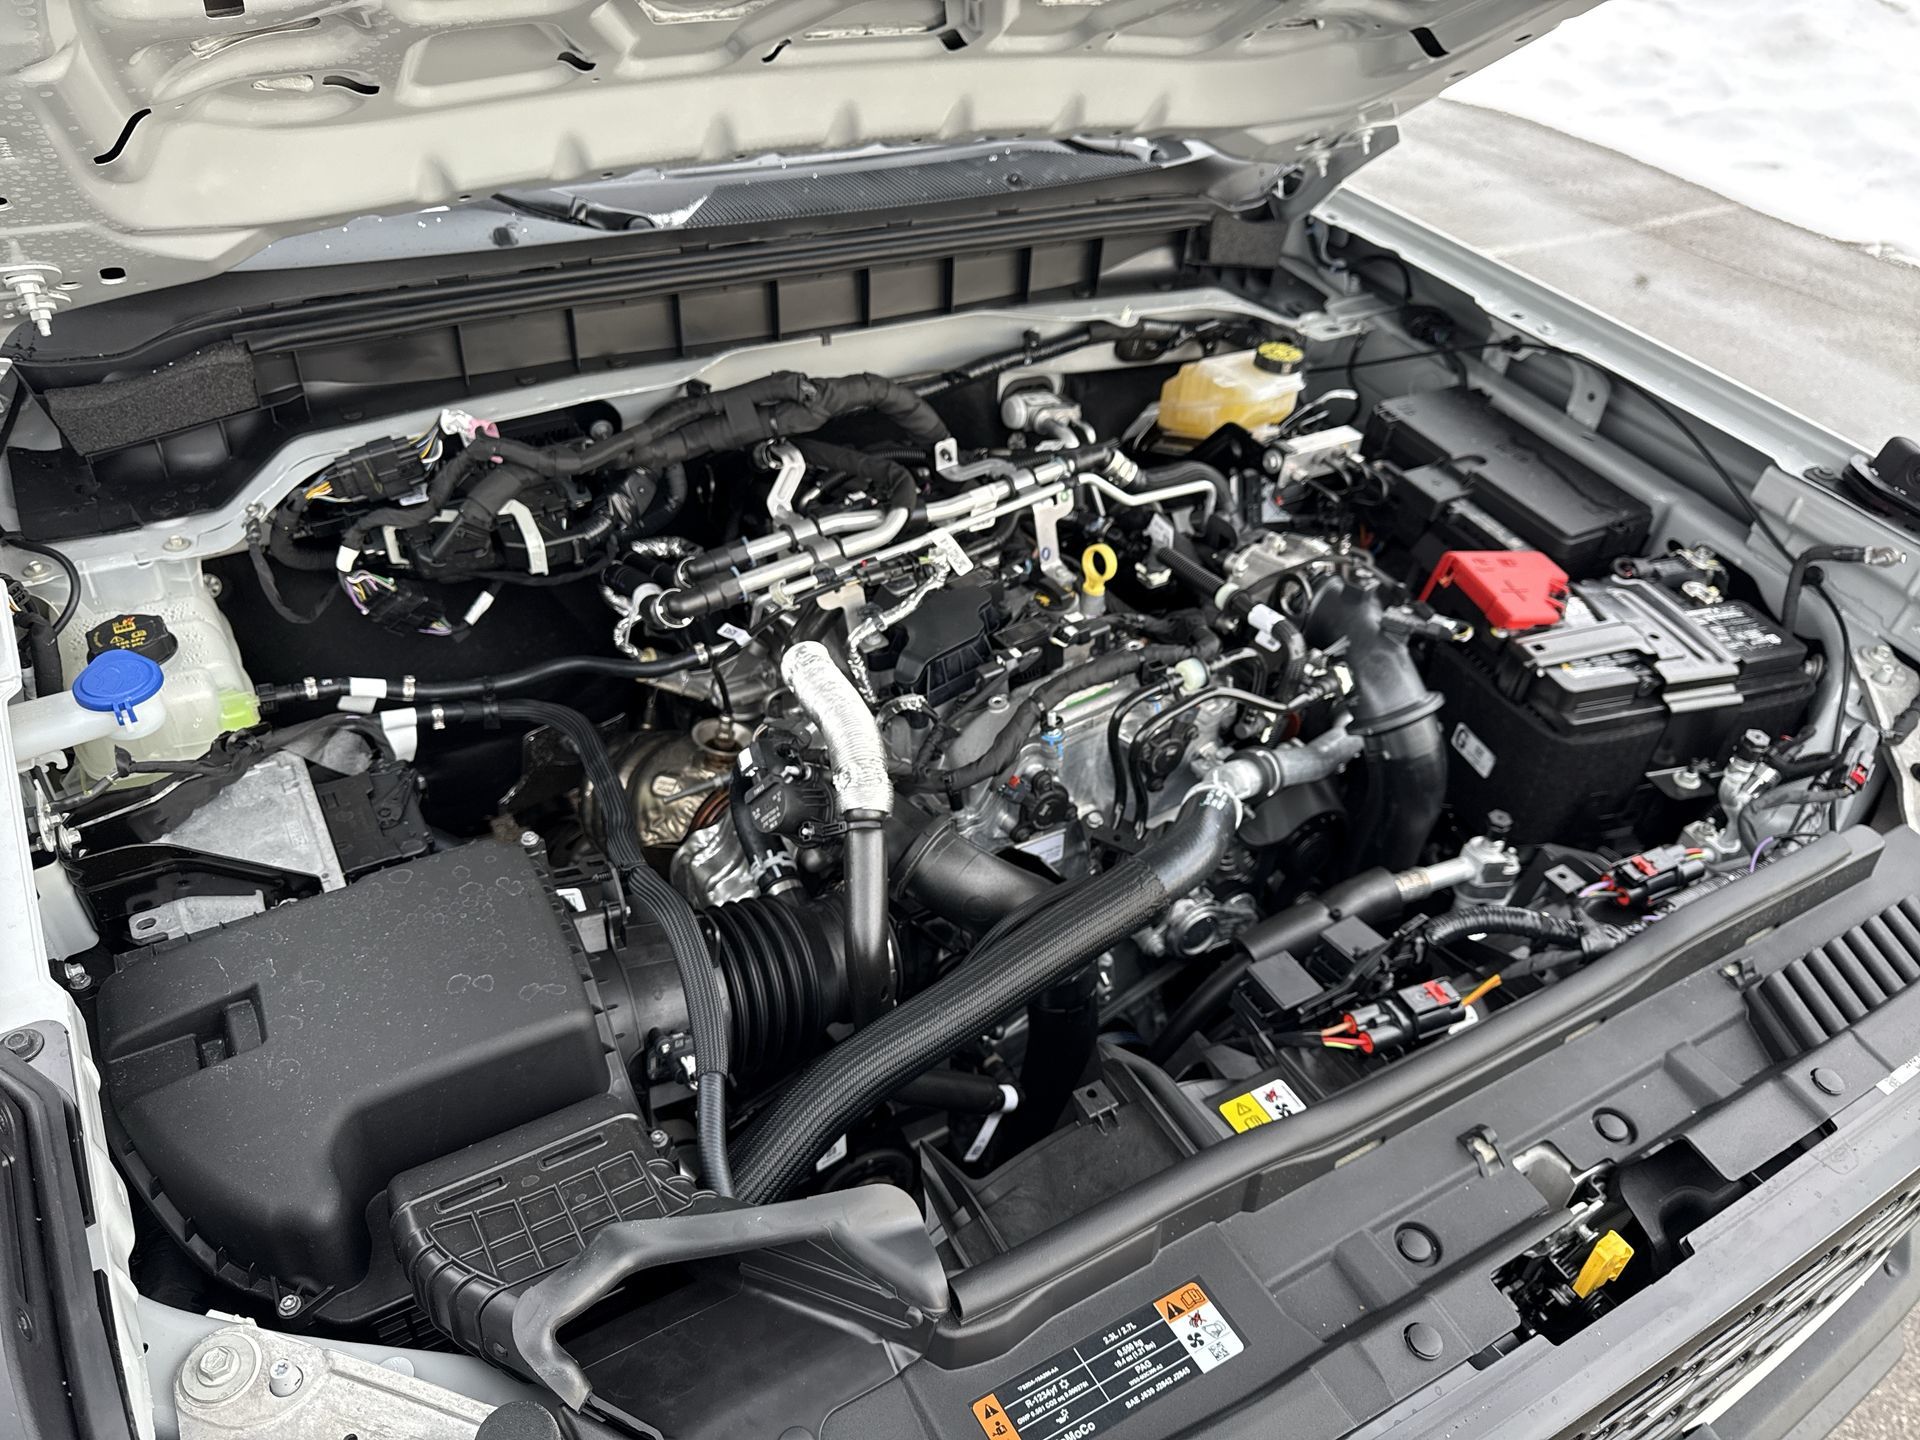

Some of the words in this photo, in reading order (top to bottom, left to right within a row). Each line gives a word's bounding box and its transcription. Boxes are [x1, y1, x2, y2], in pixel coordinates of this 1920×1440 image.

[1103, 1331, 1118, 1345] 2.3L
[1120, 1322, 1137, 1336] 2.7L
[1117, 1342, 1134, 1357] 0.550
[1132, 1339, 1144, 1351] kg
[1134, 1360, 1152, 1374] PAG
[1025, 1384, 1058, 1408] R-1234yf
[1125, 1396, 1140, 1409] SAE
[1056, 1421, 1096, 1440] MoCo
